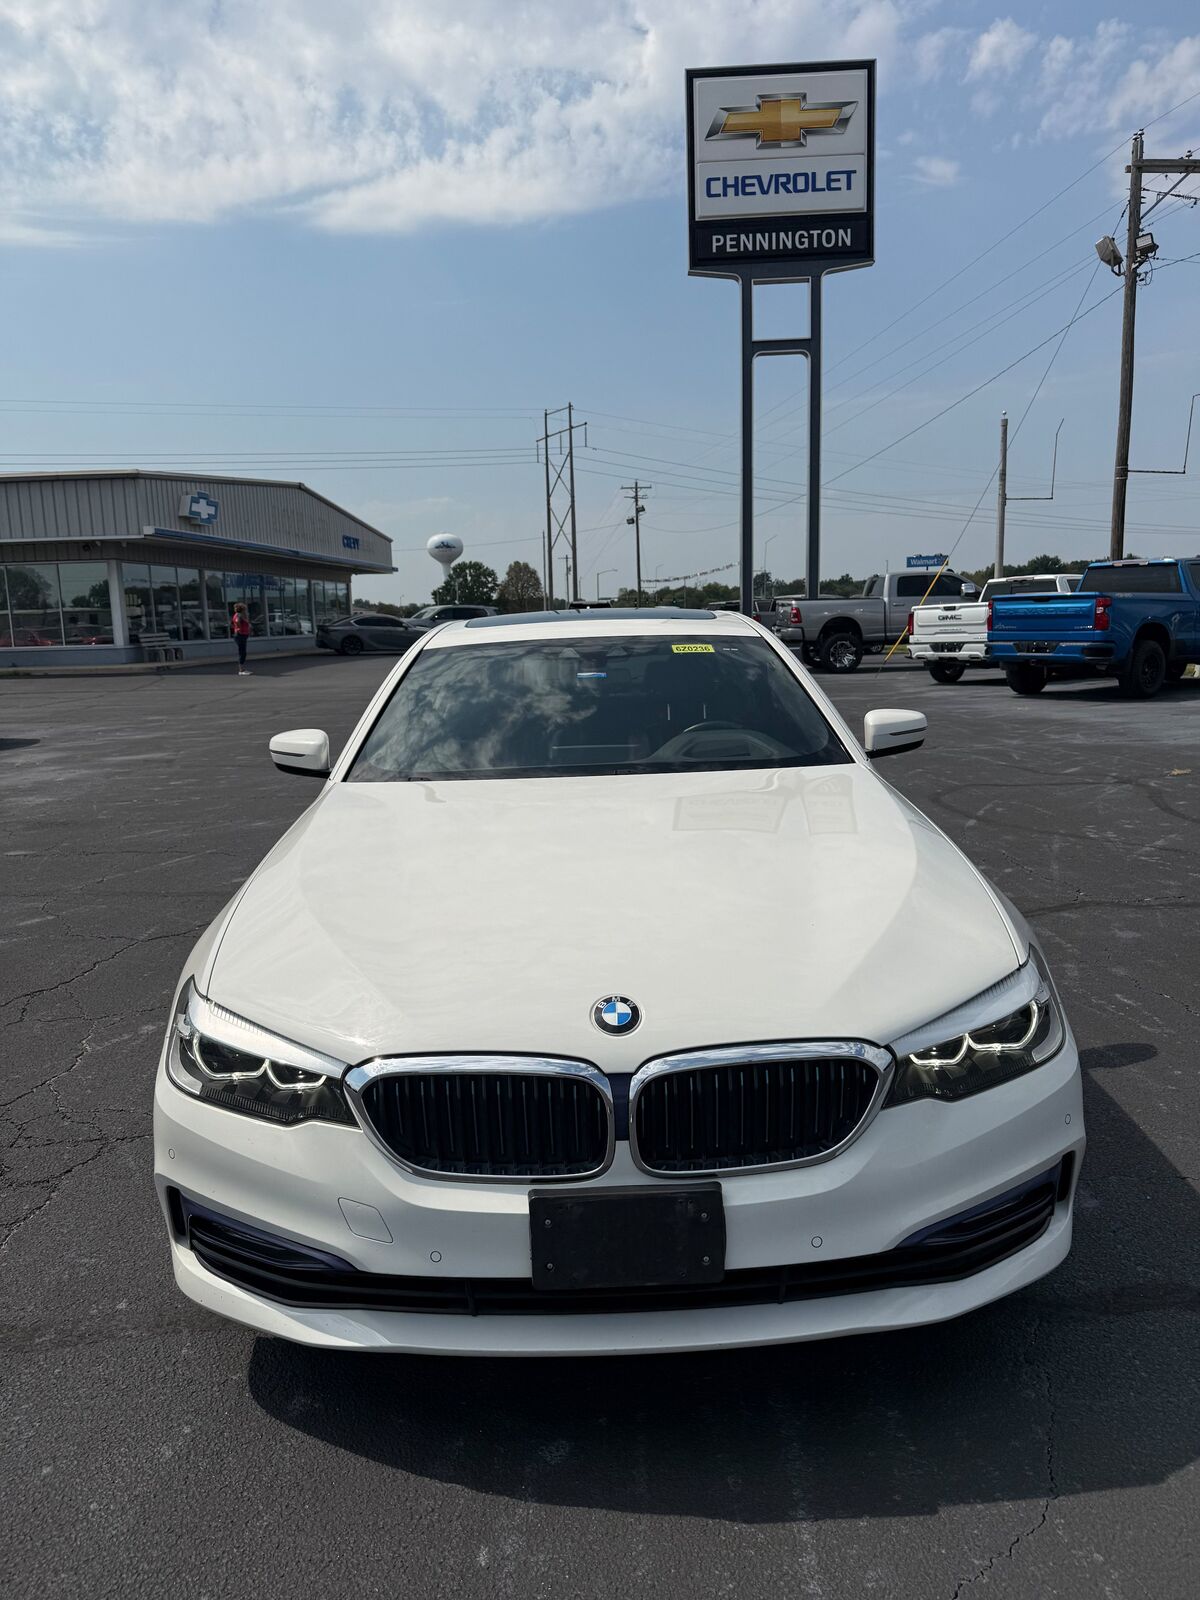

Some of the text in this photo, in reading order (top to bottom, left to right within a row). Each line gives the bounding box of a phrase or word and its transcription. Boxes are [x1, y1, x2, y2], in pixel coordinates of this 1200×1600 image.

[706, 169, 857, 198] CHEVROLET
[712, 228, 852, 253] PENNINGTON
[910, 558, 938, 566] Walmart
[597, 995, 636, 1009] BMW
